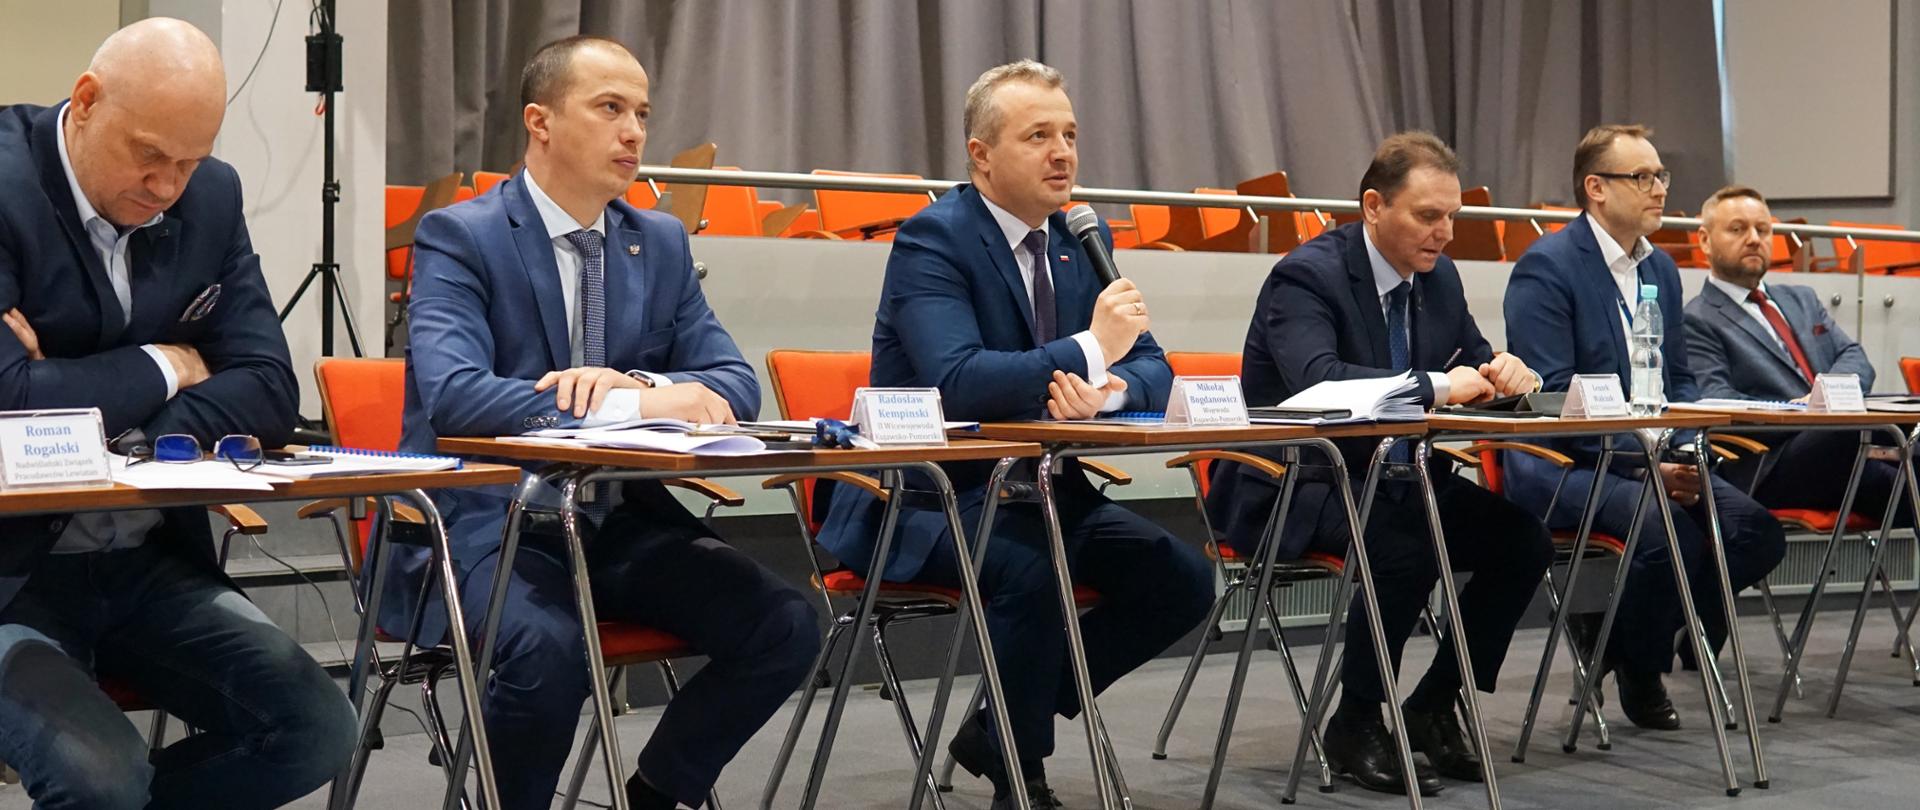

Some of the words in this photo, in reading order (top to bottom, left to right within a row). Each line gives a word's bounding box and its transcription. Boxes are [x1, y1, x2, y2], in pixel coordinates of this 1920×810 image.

[1196, 383, 1225, 392] Mikołaj
[878, 394, 923, 404] Radosław
[1190, 396, 1237, 405] Bogdanowicz
[25, 425, 72, 437] Roman
[24, 441, 80, 458] Rogalski
